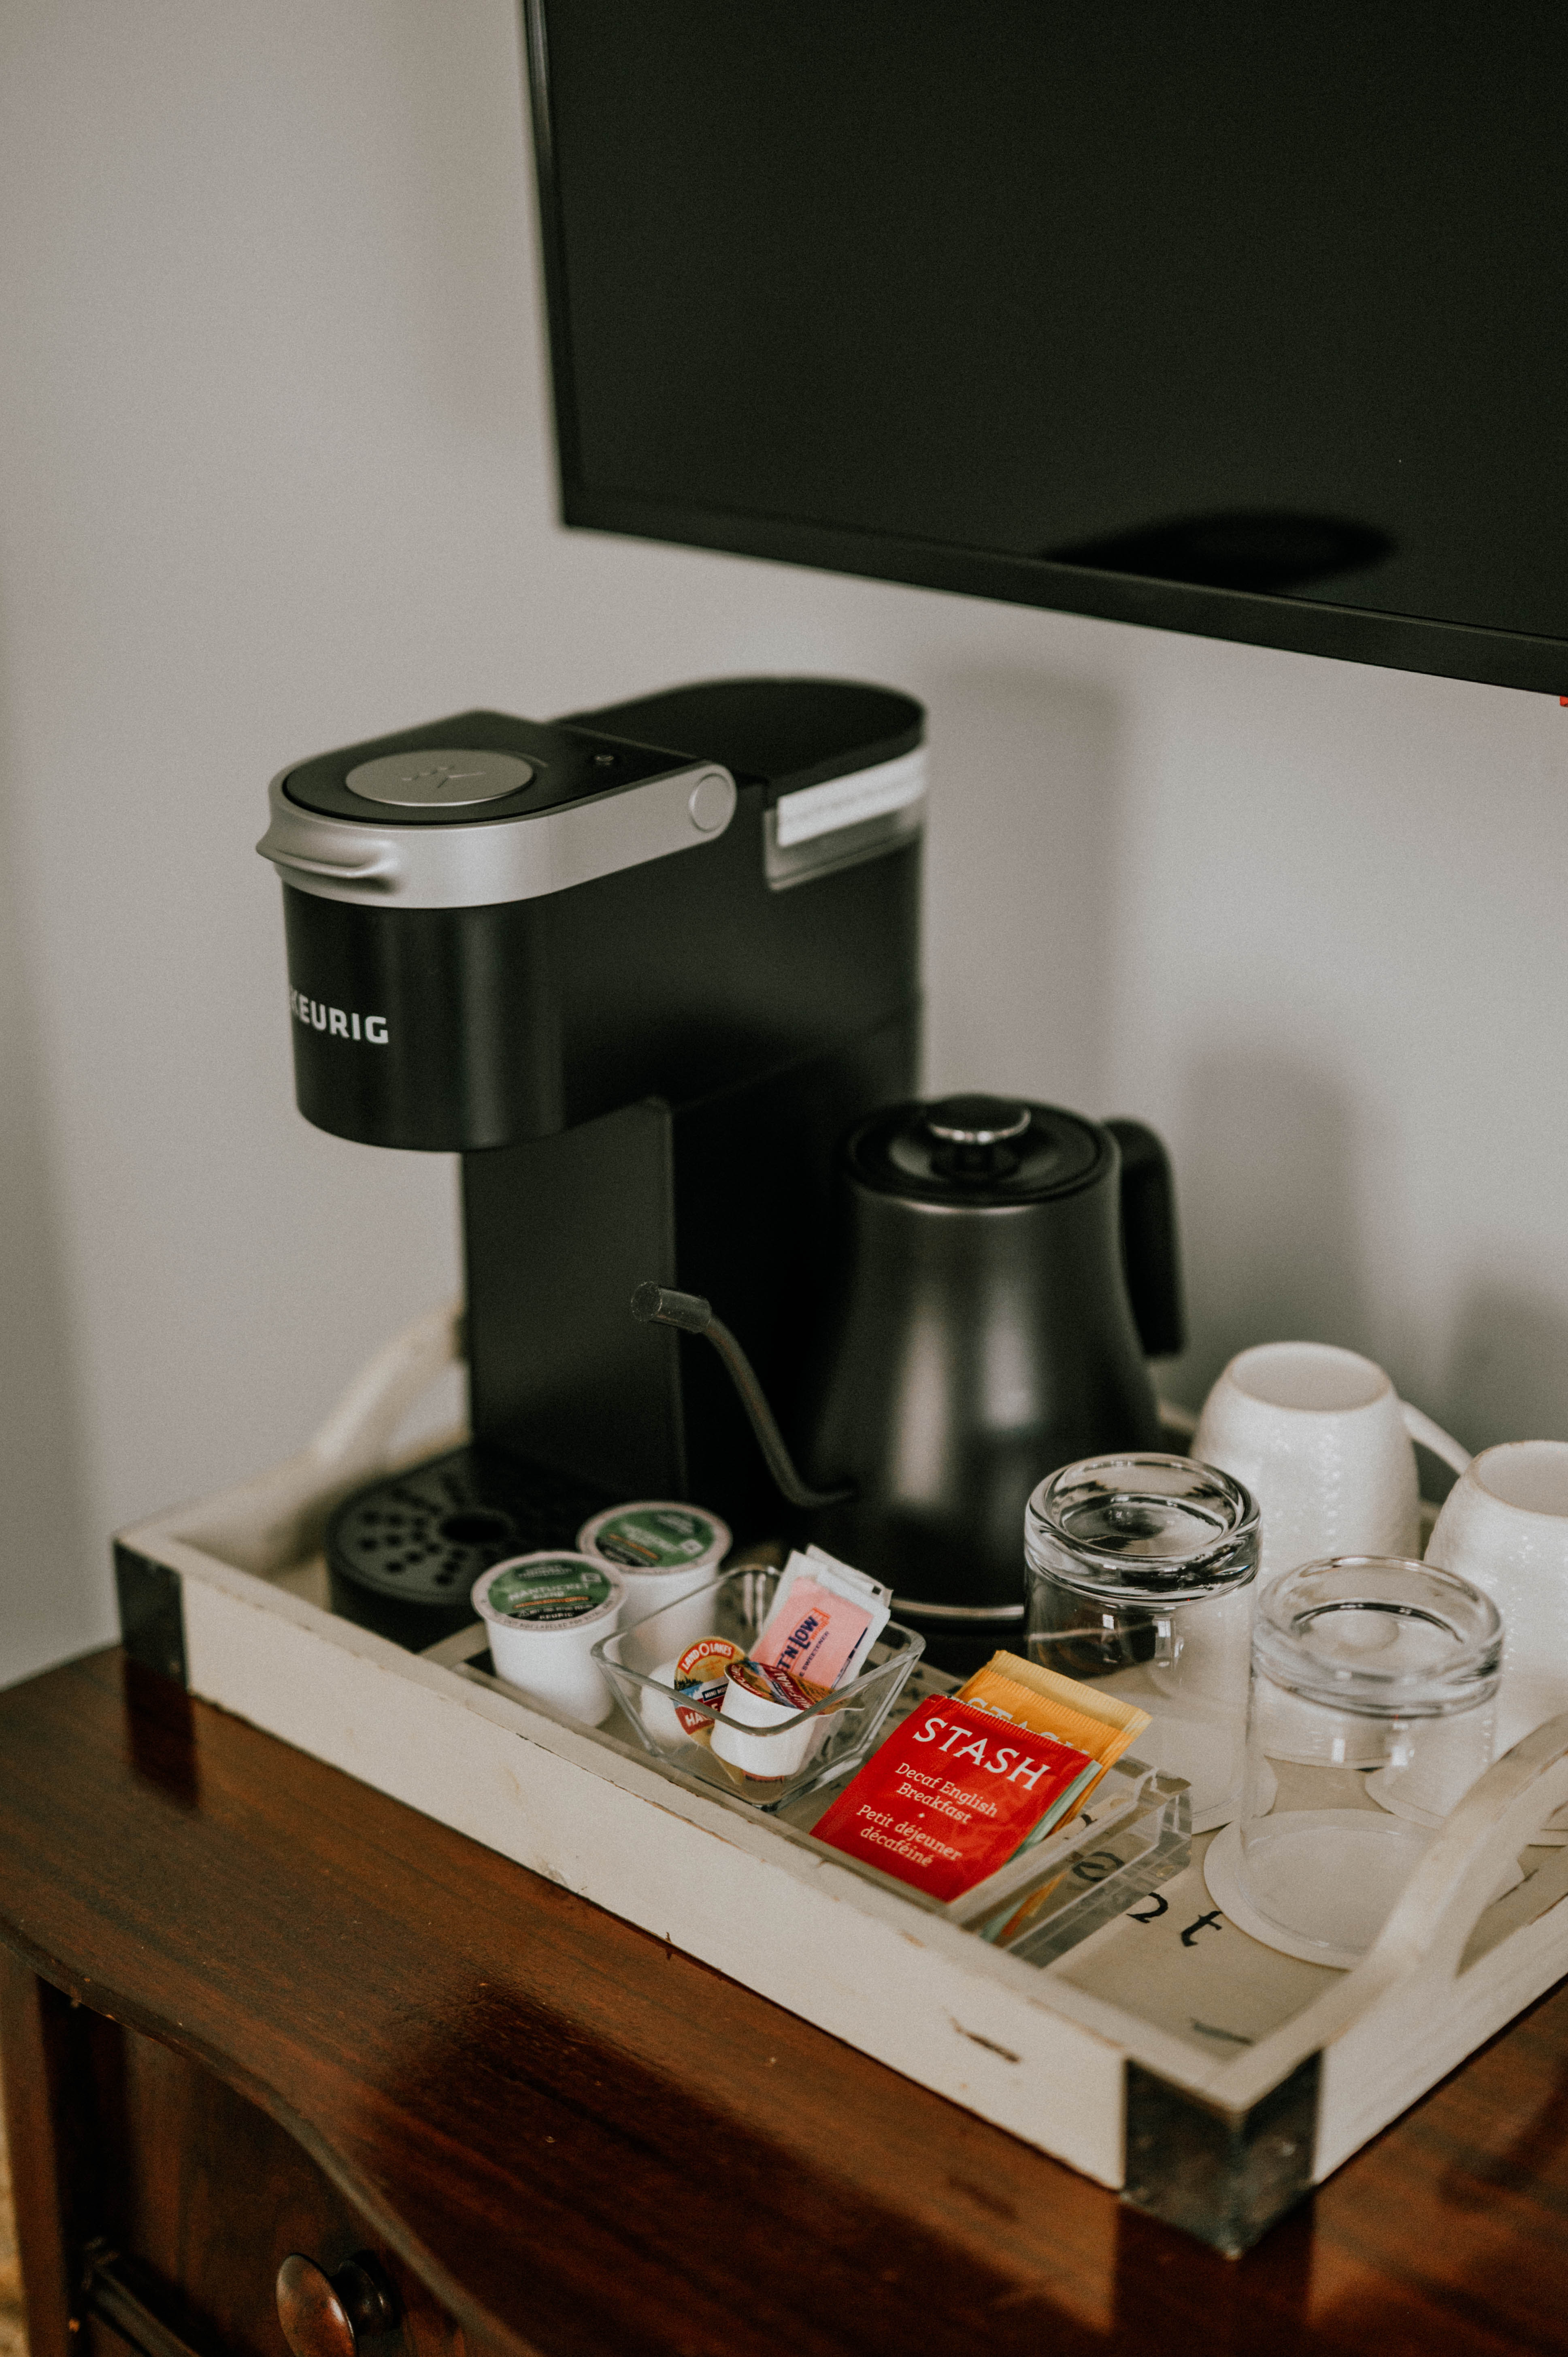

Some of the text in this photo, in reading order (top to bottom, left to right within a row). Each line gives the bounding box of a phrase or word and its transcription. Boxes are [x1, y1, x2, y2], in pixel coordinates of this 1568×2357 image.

[682, 1649, 700, 1670] LAND
[710, 1643, 732, 1656] LAKES
[802, 1630, 830, 1671] SWEETENER
[912, 1718, 1051, 1790] STASH
[895, 1763, 998, 1818] Decaf English
[896, 1782, 972, 1824] Breakfast
[856, 1804, 962, 1861] Petit déjeuner
[860, 1826, 933, 1867] décaféiné
